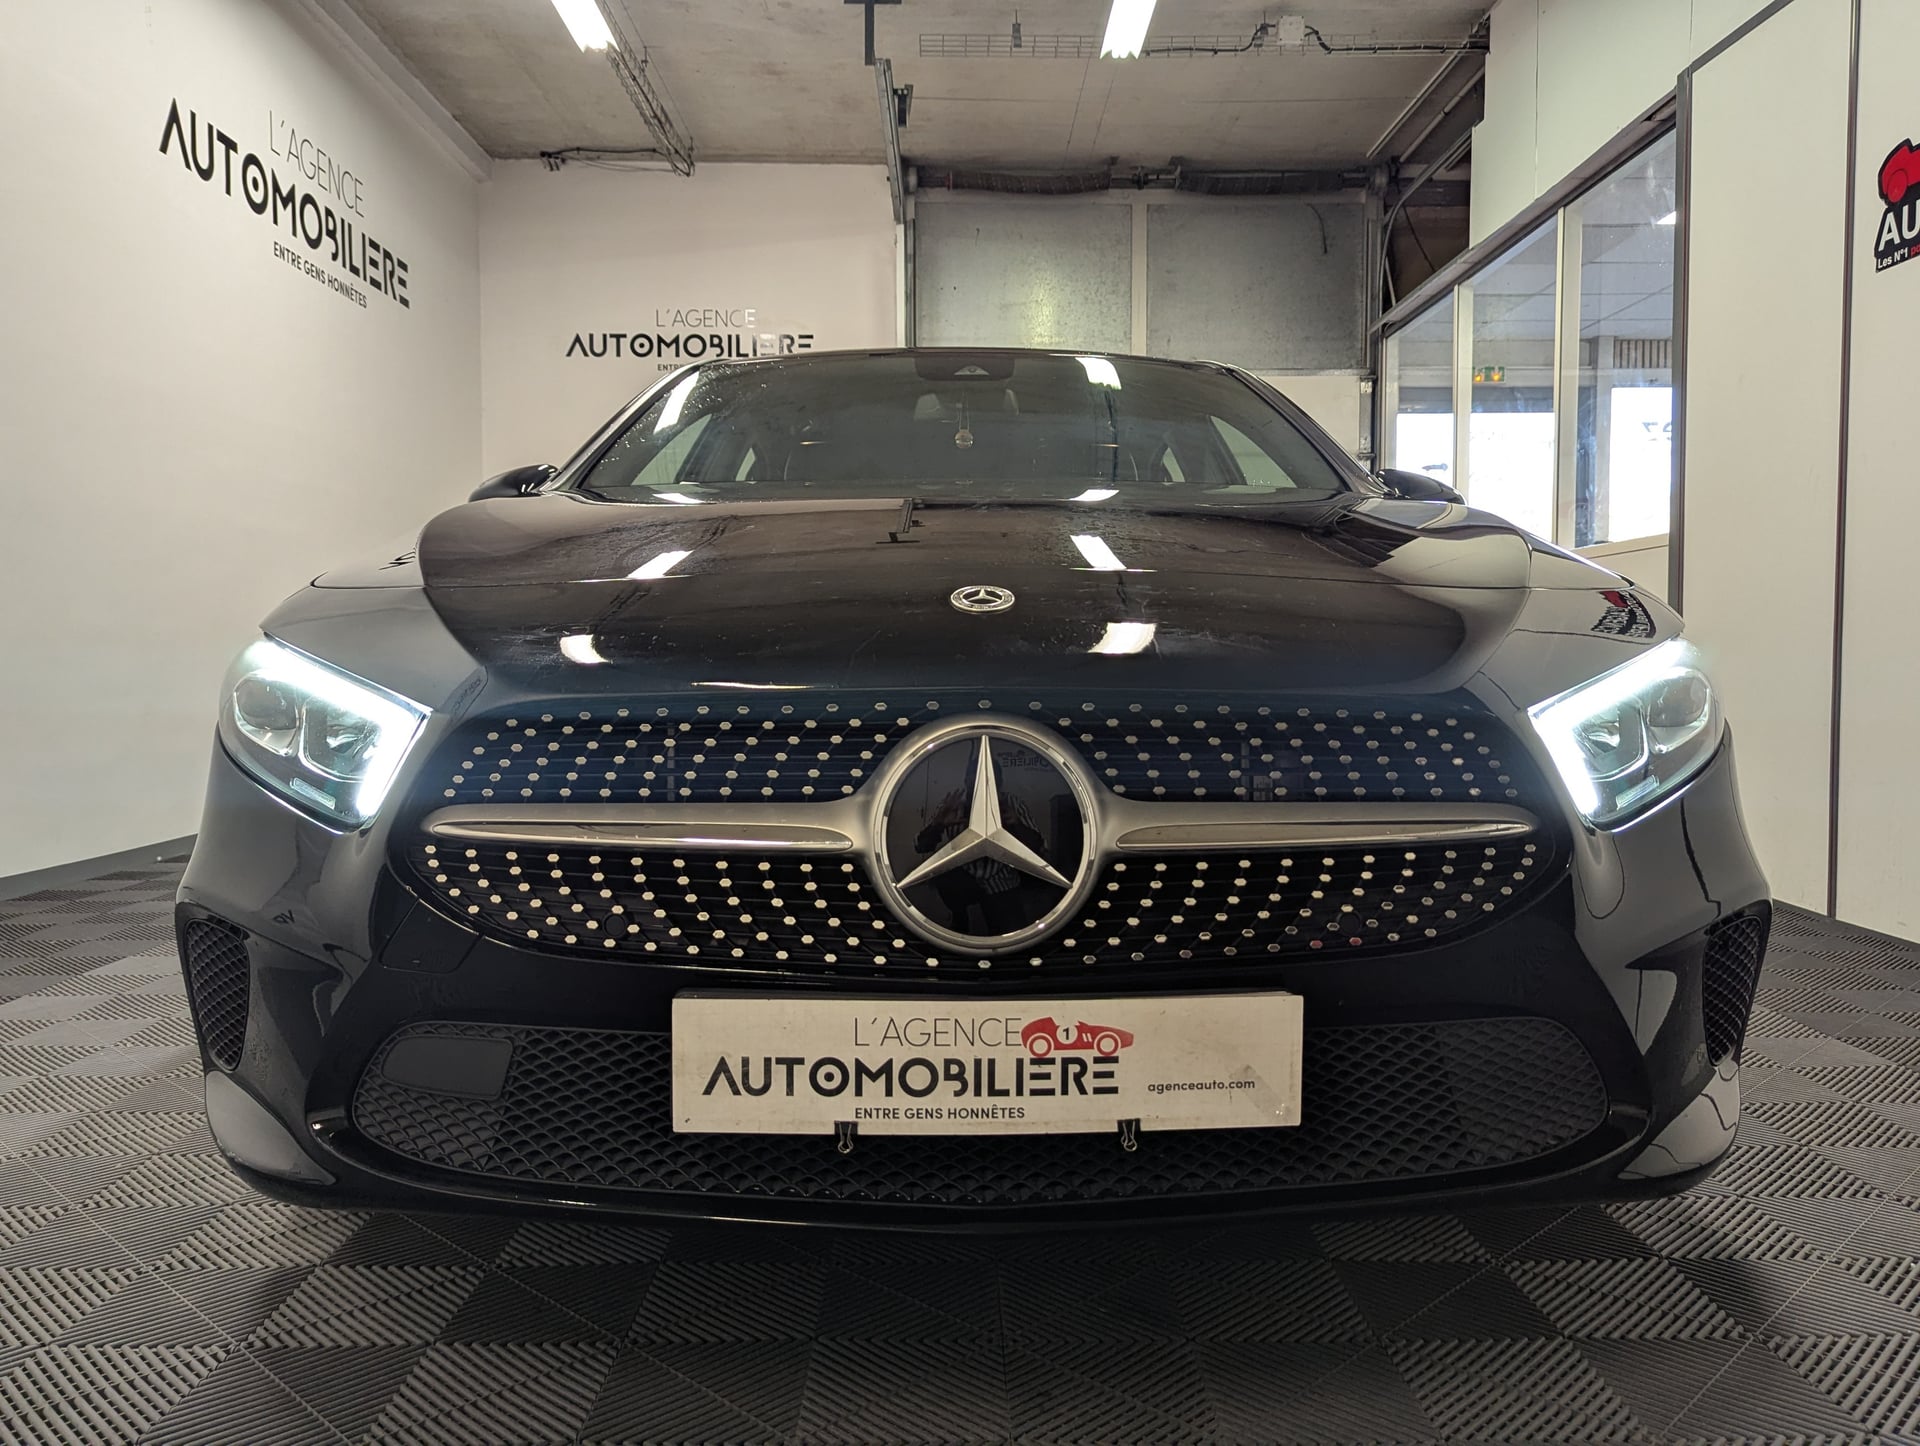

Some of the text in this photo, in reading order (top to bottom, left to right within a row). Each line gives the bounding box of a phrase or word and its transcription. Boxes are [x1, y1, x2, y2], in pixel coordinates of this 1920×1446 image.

[269, 109, 365, 218] L'AGENCE
[158, 97, 411, 310] AUTOMOBILIERE
[273, 240, 368, 309] ENTRE GENS HONNÊTES
[1878, 256, 1893, 268] Les
[656, 309, 756, 328] L'AGENCE
[854, 1016, 1022, 1047] L'AGENCE
[702, 1055, 1119, 1098] AUTOMOBILIERE
[1147, 1079, 1256, 1095] agenceauto.com
[855, 1104, 1025, 1120] ENTRE GENS HONNÊTES
